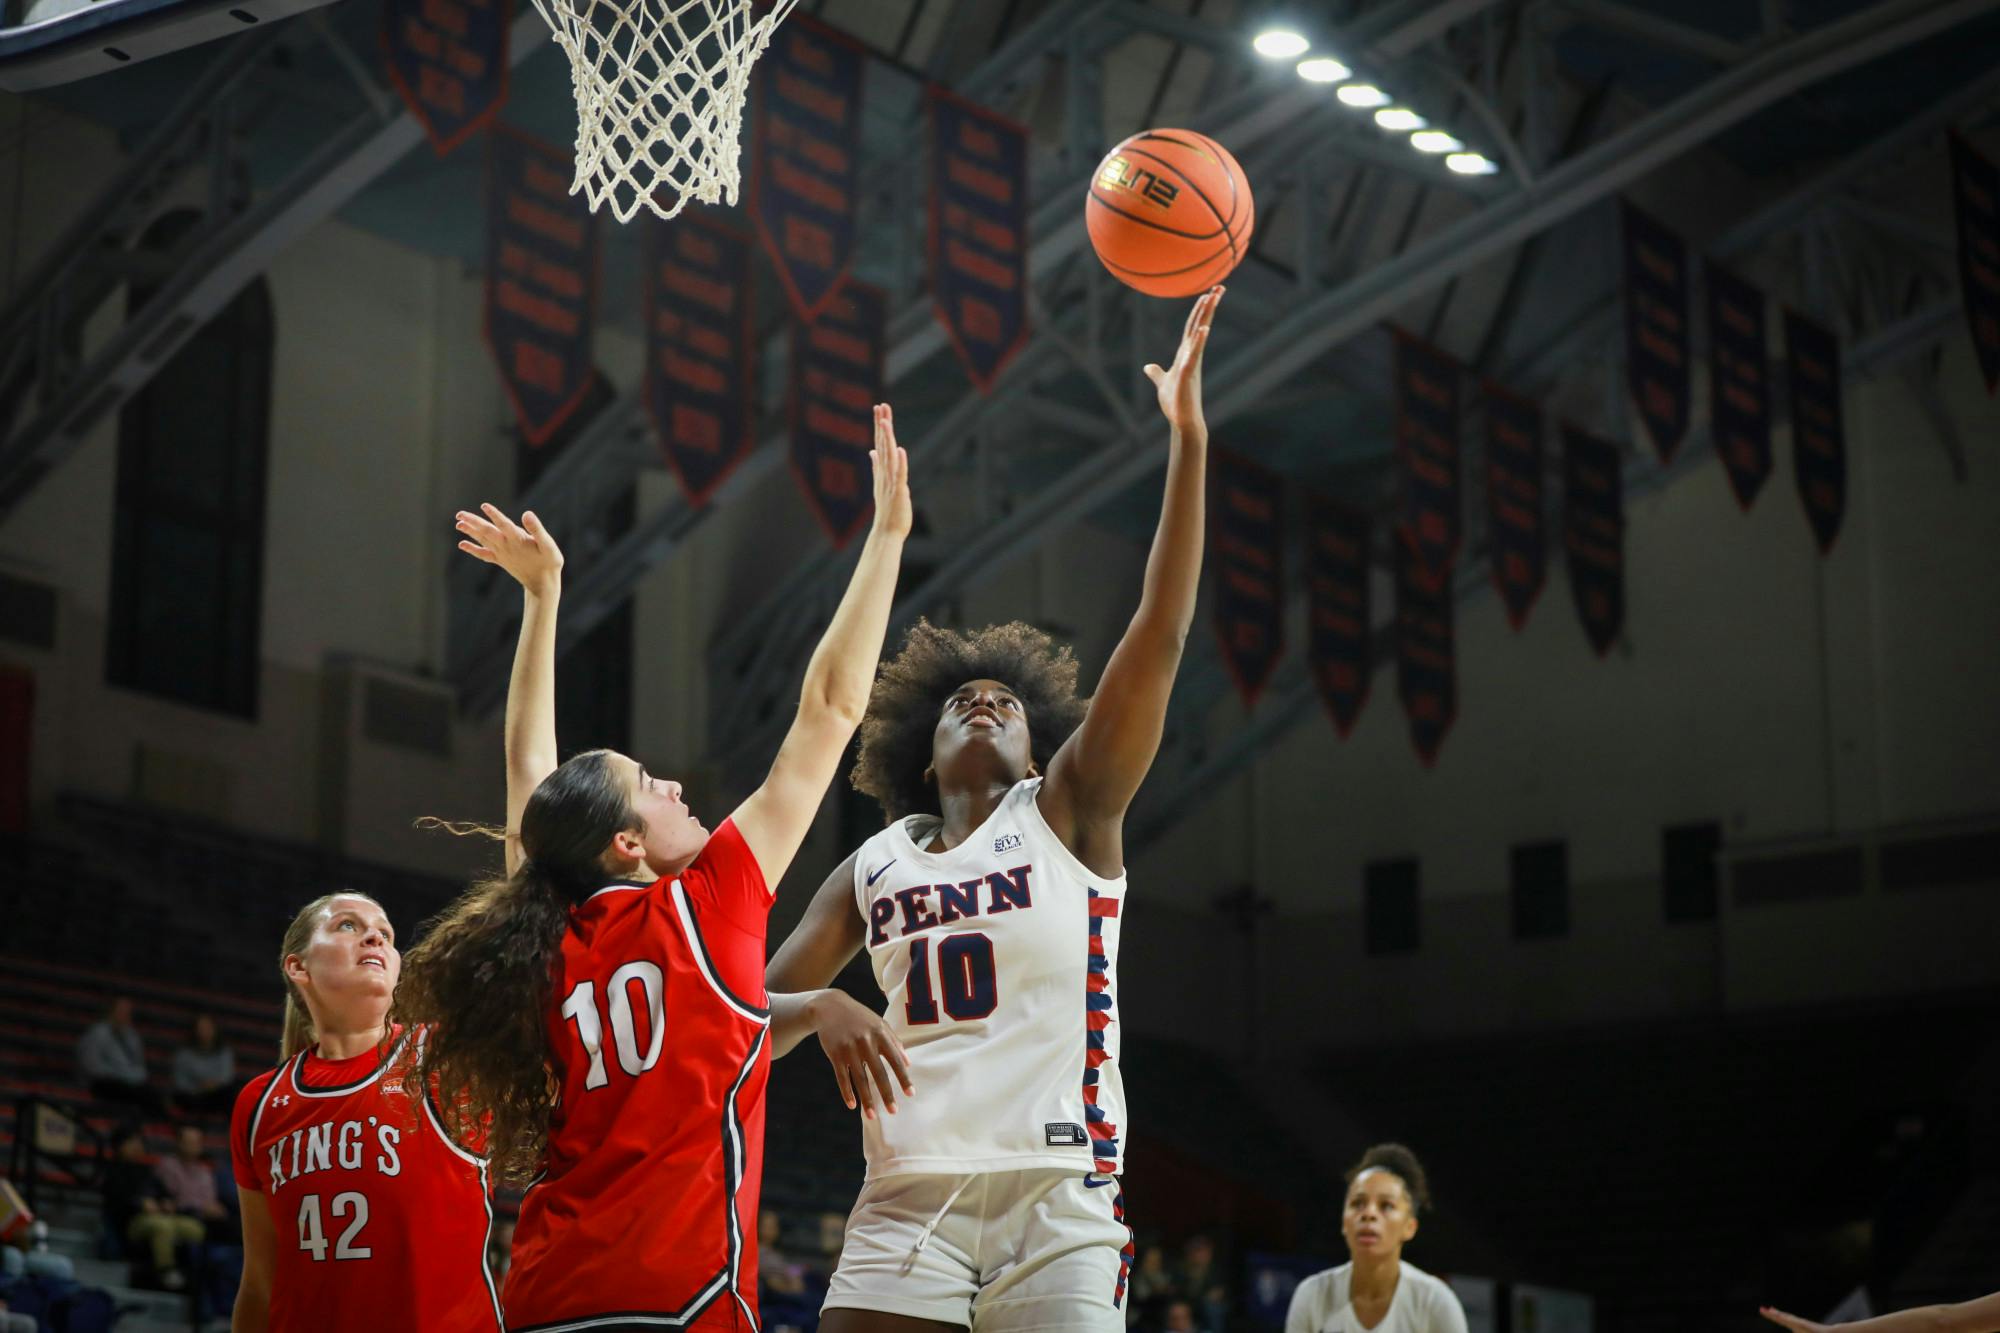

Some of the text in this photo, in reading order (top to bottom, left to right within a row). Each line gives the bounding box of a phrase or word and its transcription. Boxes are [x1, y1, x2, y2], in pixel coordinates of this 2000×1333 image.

[1002, 833, 1021, 848] IVY
[870, 864, 1032, 947] PENN
[905, 932, 998, 1025] 10
[562, 960, 665, 1091] 10
[269, 1115, 401, 1195] KING'S
[298, 1190, 372, 1261] 42
